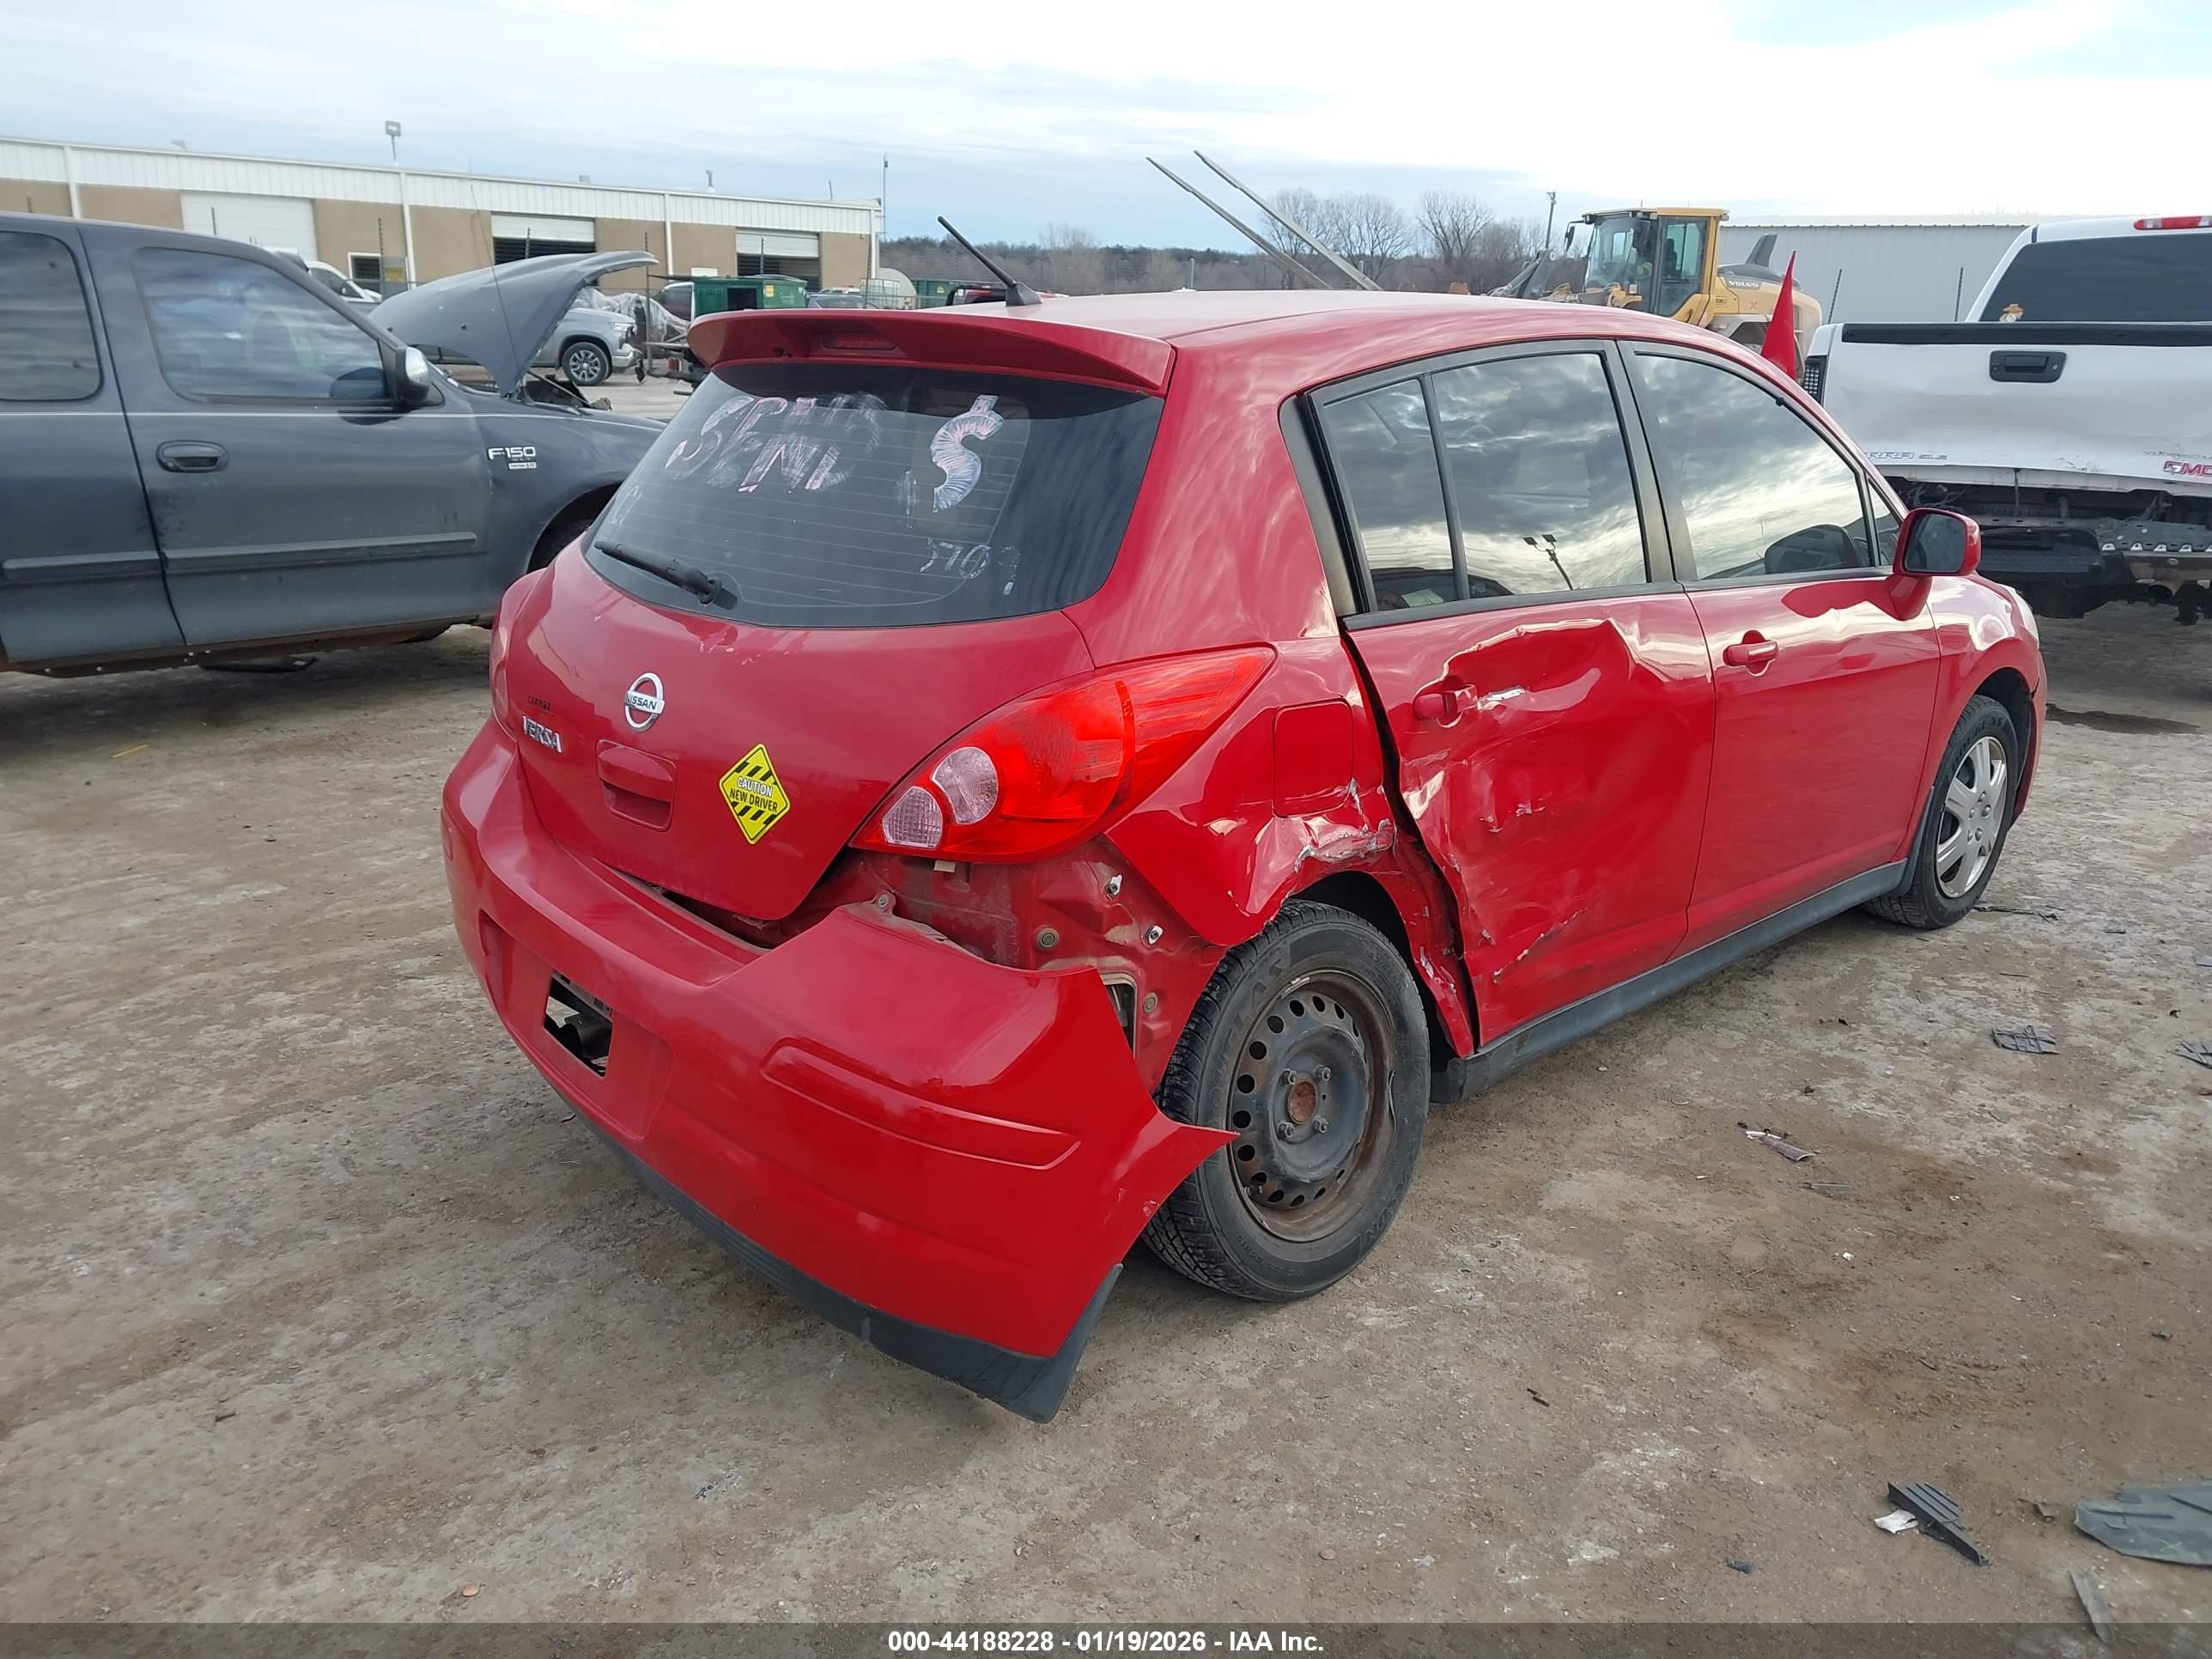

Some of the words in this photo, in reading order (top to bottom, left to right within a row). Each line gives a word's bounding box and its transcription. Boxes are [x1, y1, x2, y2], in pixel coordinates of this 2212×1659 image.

[626, 694, 658, 711] NISSAN
[522, 714, 563, 754] VERSA
[737, 776, 774, 798] CAUTION
[729, 787, 748, 803] NEW
[749, 793, 779, 813] DRIVER
